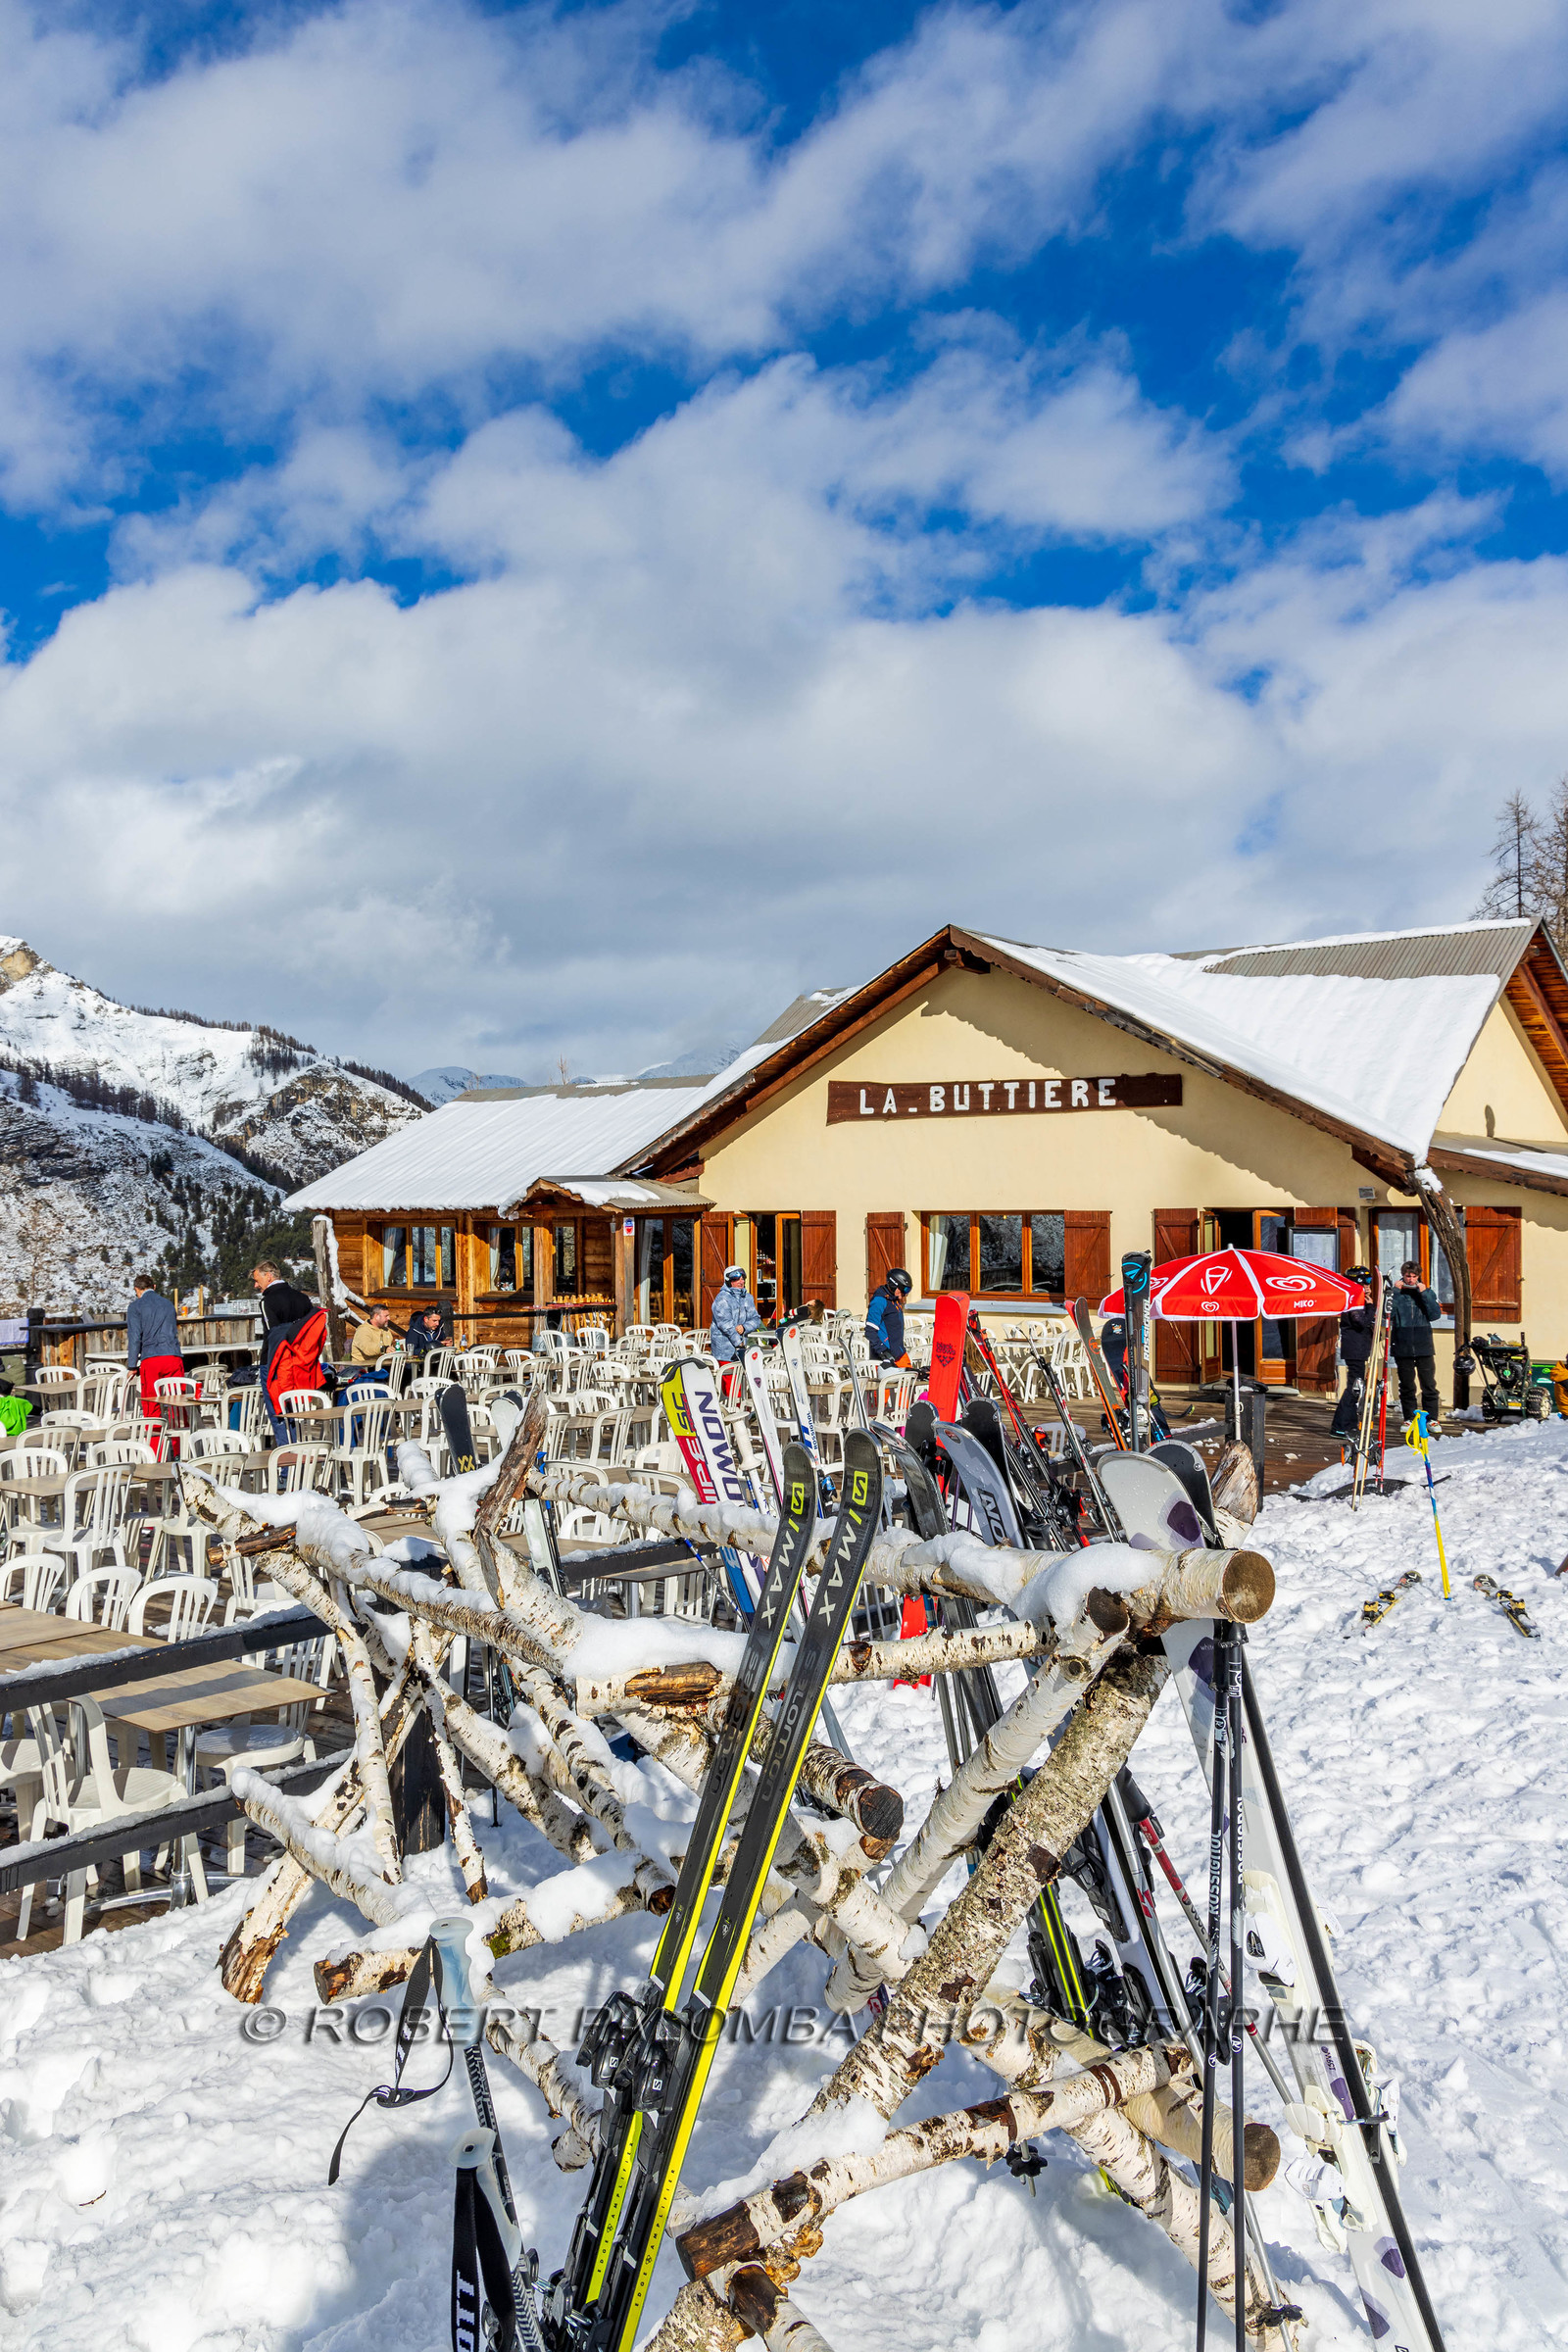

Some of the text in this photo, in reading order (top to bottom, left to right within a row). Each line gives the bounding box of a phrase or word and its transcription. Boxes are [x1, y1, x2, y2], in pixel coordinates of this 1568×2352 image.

[859, 1088, 897, 1114] LA
[929, 1079, 1116, 1112] BUTTIERE
[1294, 1299, 1314, 1308] MIKO
[806, 1410, 818, 1450] ROSSIGNOL
[1208, 1829, 1222, 1915] ROSSIGNOL
[611, 2142, 633, 2219] AMPLIFIER
[650, 2169, 675, 2250] AMPLIFIER
